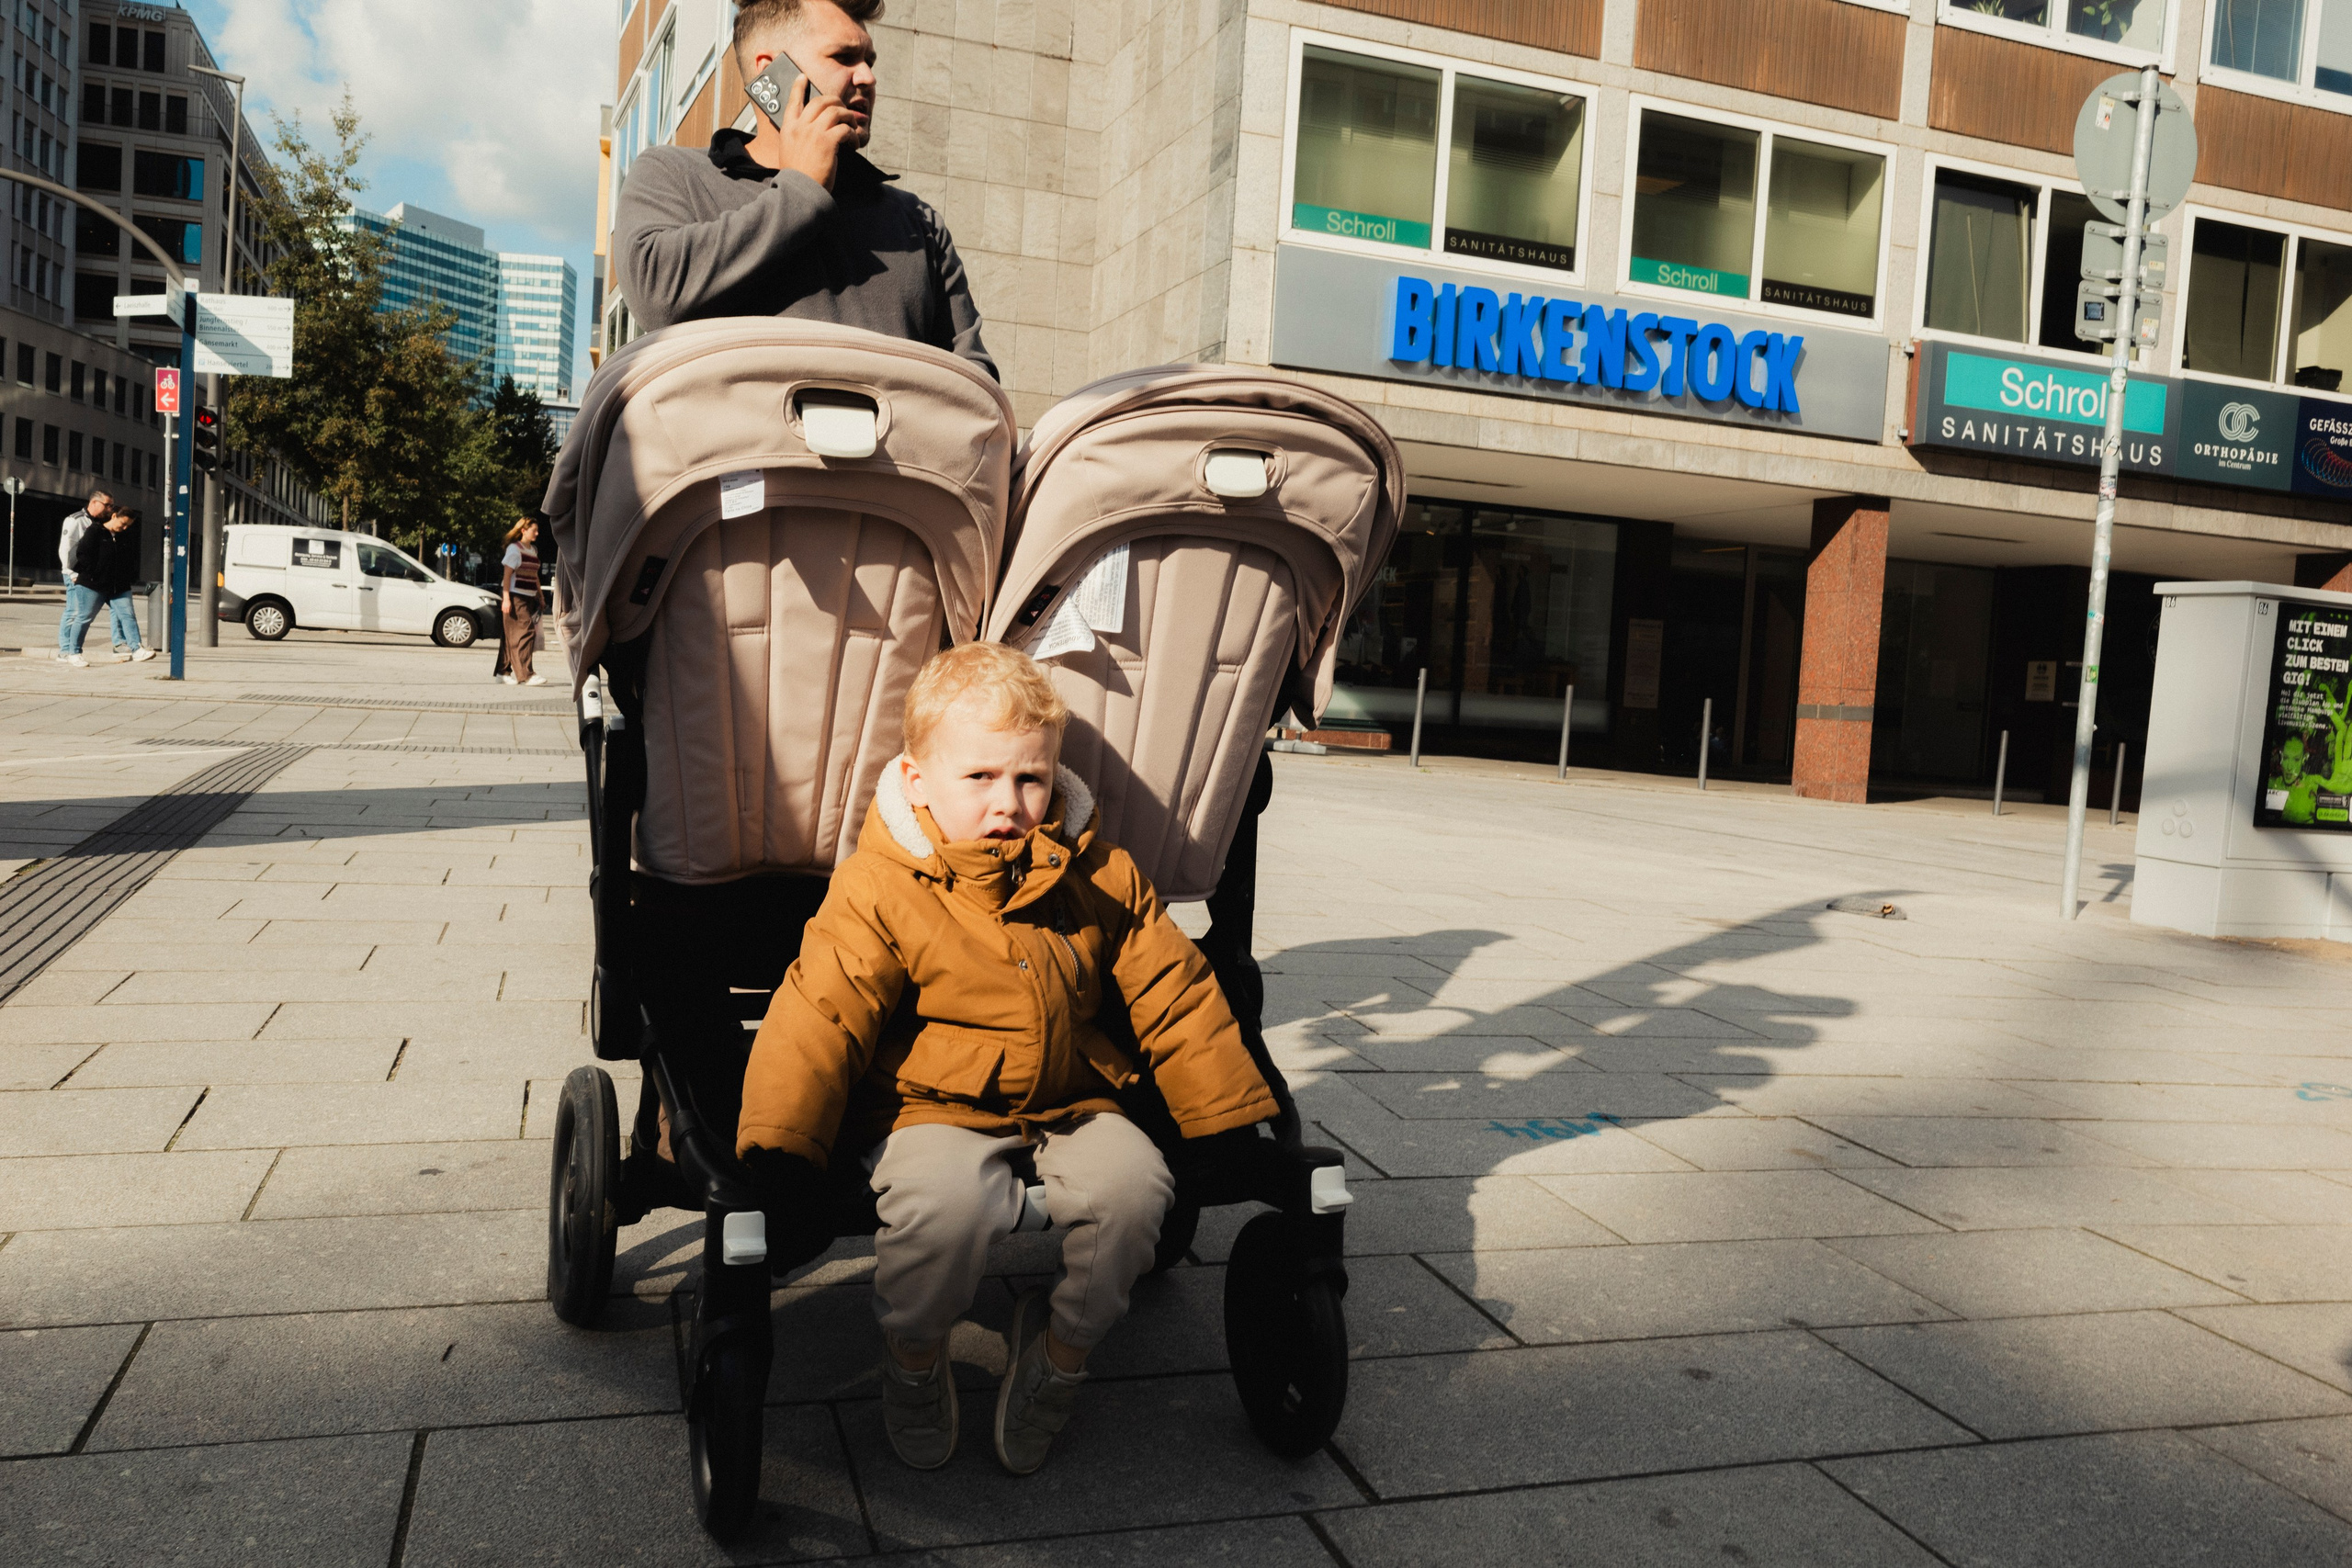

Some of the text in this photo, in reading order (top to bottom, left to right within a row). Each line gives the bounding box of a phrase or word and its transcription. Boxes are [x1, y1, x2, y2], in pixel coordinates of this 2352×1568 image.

[117, 6, 164, 22] KPMG
[1326, 211, 1396, 242] Schroll
[1449, 235, 1567, 265] SANITÄTSHAUS
[1657, 264, 1719, 292] Schroll
[199, 296, 227, 305] Rathaus
[1764, 286, 1868, 312] SANITÄTSHAUS
[198, 316, 243, 326] Jungfernstieg
[198, 325, 240, 333] Binnenalster
[198, 339, 239, 348] Gänsemarkt
[1388, 276, 1804, 413] BIRKENSTOCK
[207, 359, 249, 368] Hanseviertel
[1999, 367, 2109, 420] Schrol
[2330, 435, 2348, 447] Große
[2193, 443, 2279, 465] ORTHOPÄDIE
[2218, 458, 2252, 470] im Centrum
[2165, 596, 2177, 608] 86
[2258, 602, 2268, 615] 86
[2289, 619, 2347, 638] MIT EINEM
[2286, 637, 2324, 653] CLICK
[2284, 653, 2349, 673] ZUM BESTEN
[2282, 671, 2312, 686] GIG!
[2292, 698, 2320, 706] clubplan
[2306, 692, 2324, 700] jetzt
[2278, 711, 2314, 721] vielfältige
[2307, 707, 2334, 716] Hamburgs
